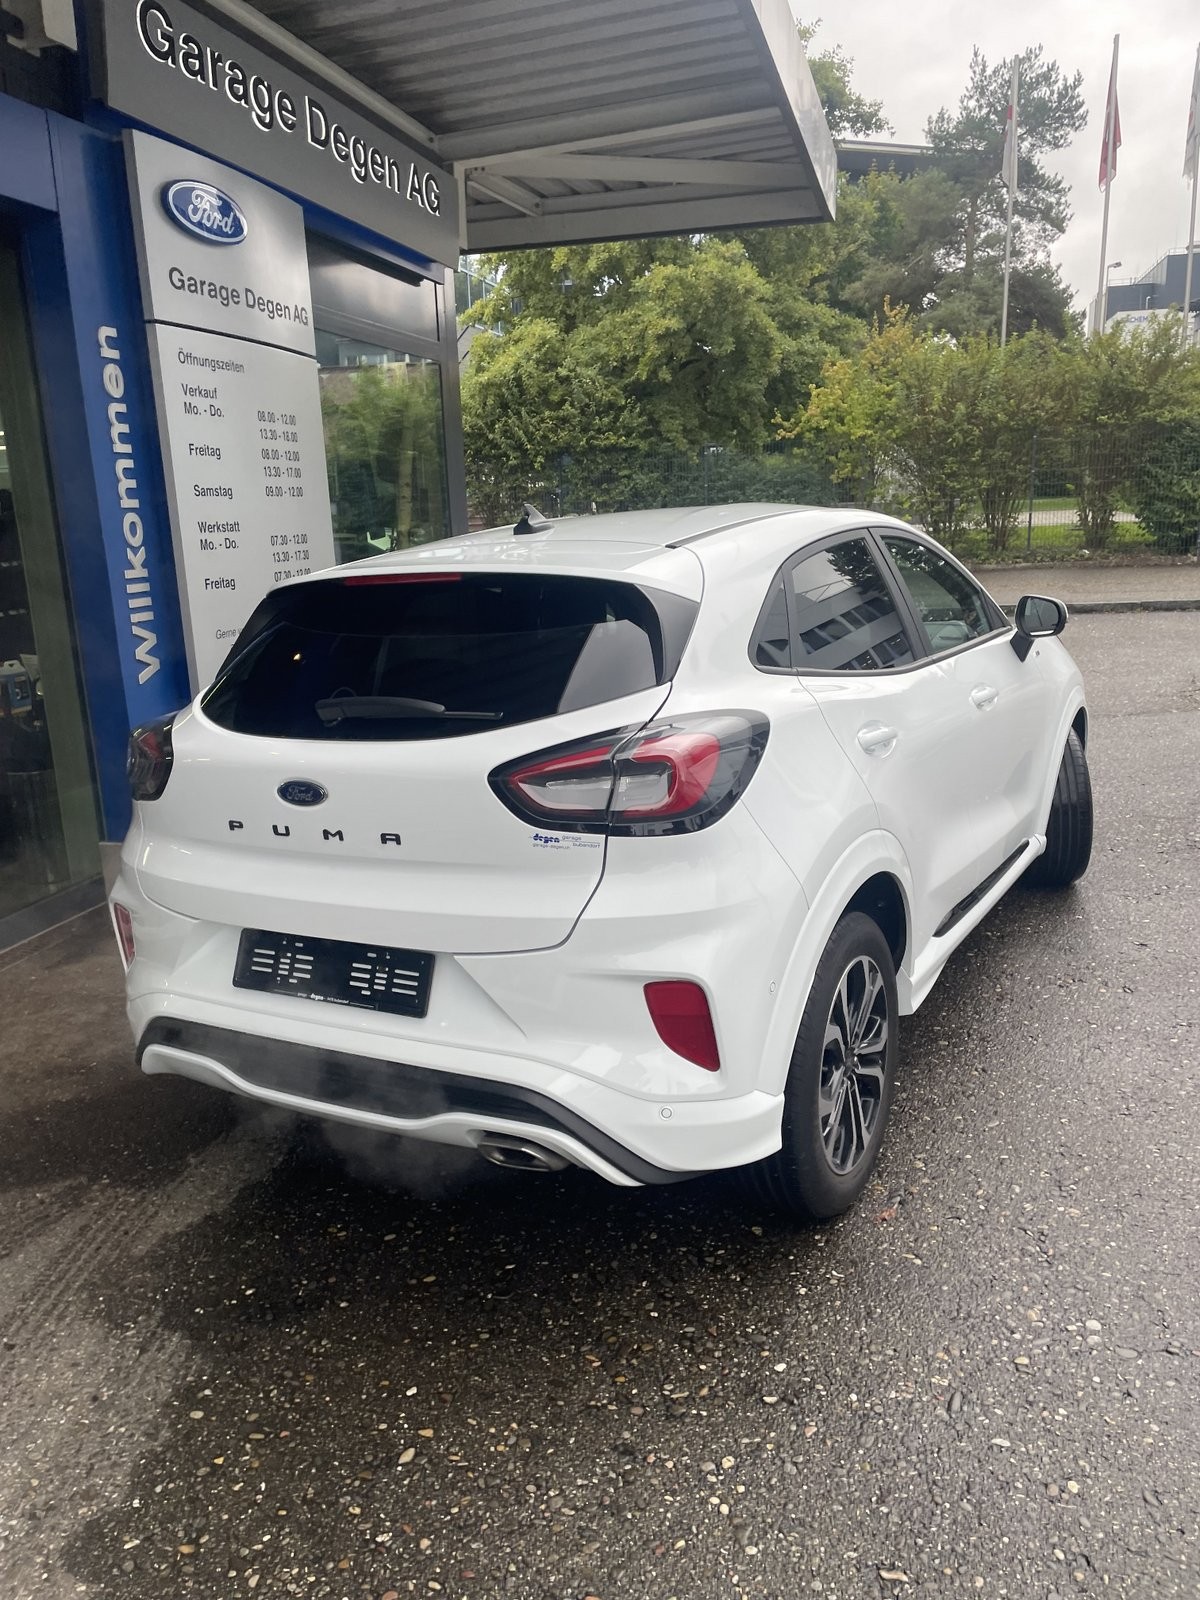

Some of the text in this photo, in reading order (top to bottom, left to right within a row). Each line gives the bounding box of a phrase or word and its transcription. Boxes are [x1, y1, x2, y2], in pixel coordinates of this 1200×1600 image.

[136, 0, 440, 216] Garage Degen AG
[188, 189, 235, 234] Ford
[168, 266, 309, 326] Garage Degen AG
[178, 347, 245, 373] Öffnungszeiten
[181, 383, 218, 399] Verkauf
[183, 401, 201, 415] Mo.
[209, 404, 224, 417] Do.
[257, 410, 276, 423] 08.00
[281, 414, 296, 426] 12.00
[260, 428, 278, 440] 13.30
[188, 443, 221, 459] Freitag
[261, 448, 280, 460] 08.00
[284, 450, 300, 461] 12.00
[263, 466, 281, 477] 13.30
[286, 467, 302, 478] 17.00
[193, 484, 233, 500] Samstag
[265, 486, 283, 497] 09.00
[288, 486, 304, 497] 12.00
[98, 326, 160, 685] Willkommen
[197, 521, 241, 533] Werkstatt
[200, 538, 217, 551] Mo.
[224, 537, 239, 549] Do.
[270, 534, 288, 546] 07.30
[292, 533, 308, 544] 12.00
[272, 551, 290, 562] 13.30
[294, 549, 310, 560] 17.30
[204, 578, 236, 590] Freitag
[215, 628, 237, 639] Gerne
[286, 784, 314, 801] Ford
[228, 819, 402, 846] PUMA
[532, 833, 560, 843] degen
